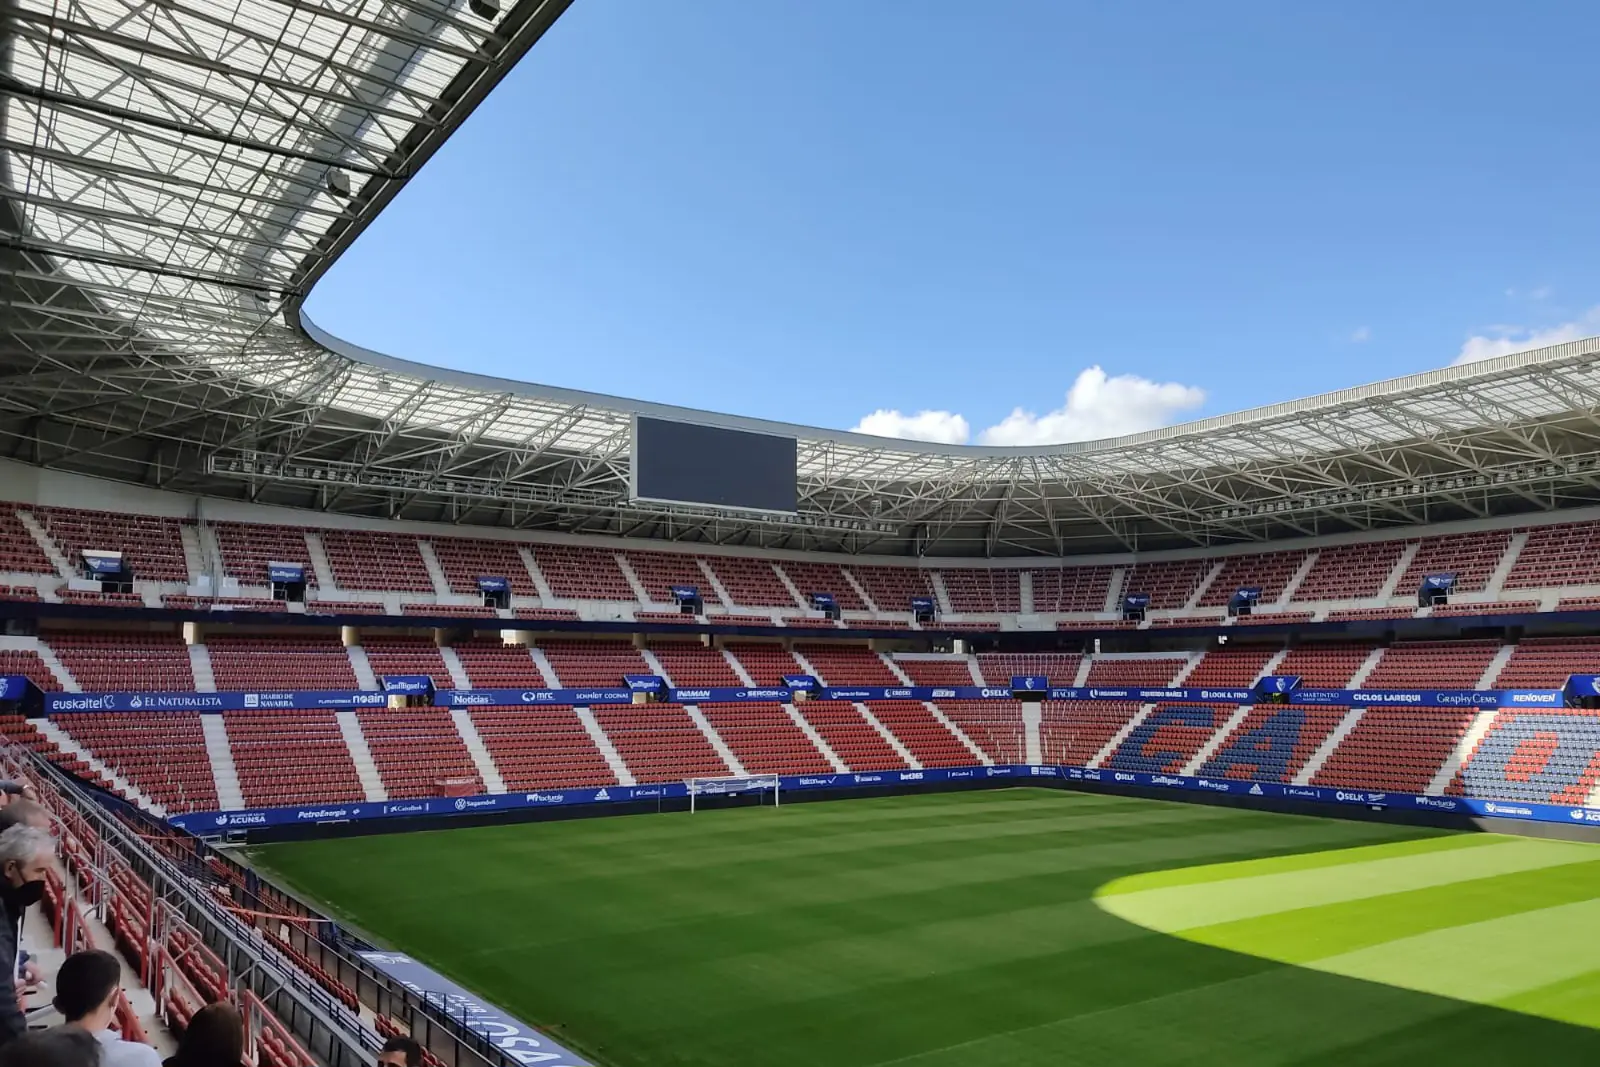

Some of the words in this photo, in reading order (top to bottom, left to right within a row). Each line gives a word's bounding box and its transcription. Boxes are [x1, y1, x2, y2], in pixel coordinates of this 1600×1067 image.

[454, 695, 489, 704] Noticias
[1353, 694, 1383, 702] CICLOS
[1384, 694, 1421, 704] LAREQUI
[52, 698, 103, 710] euskaltel
[260, 700, 294, 708] NAVARRA
[1344, 793, 1365, 802] SELK
[229, 815, 267, 825] ACUNSA
